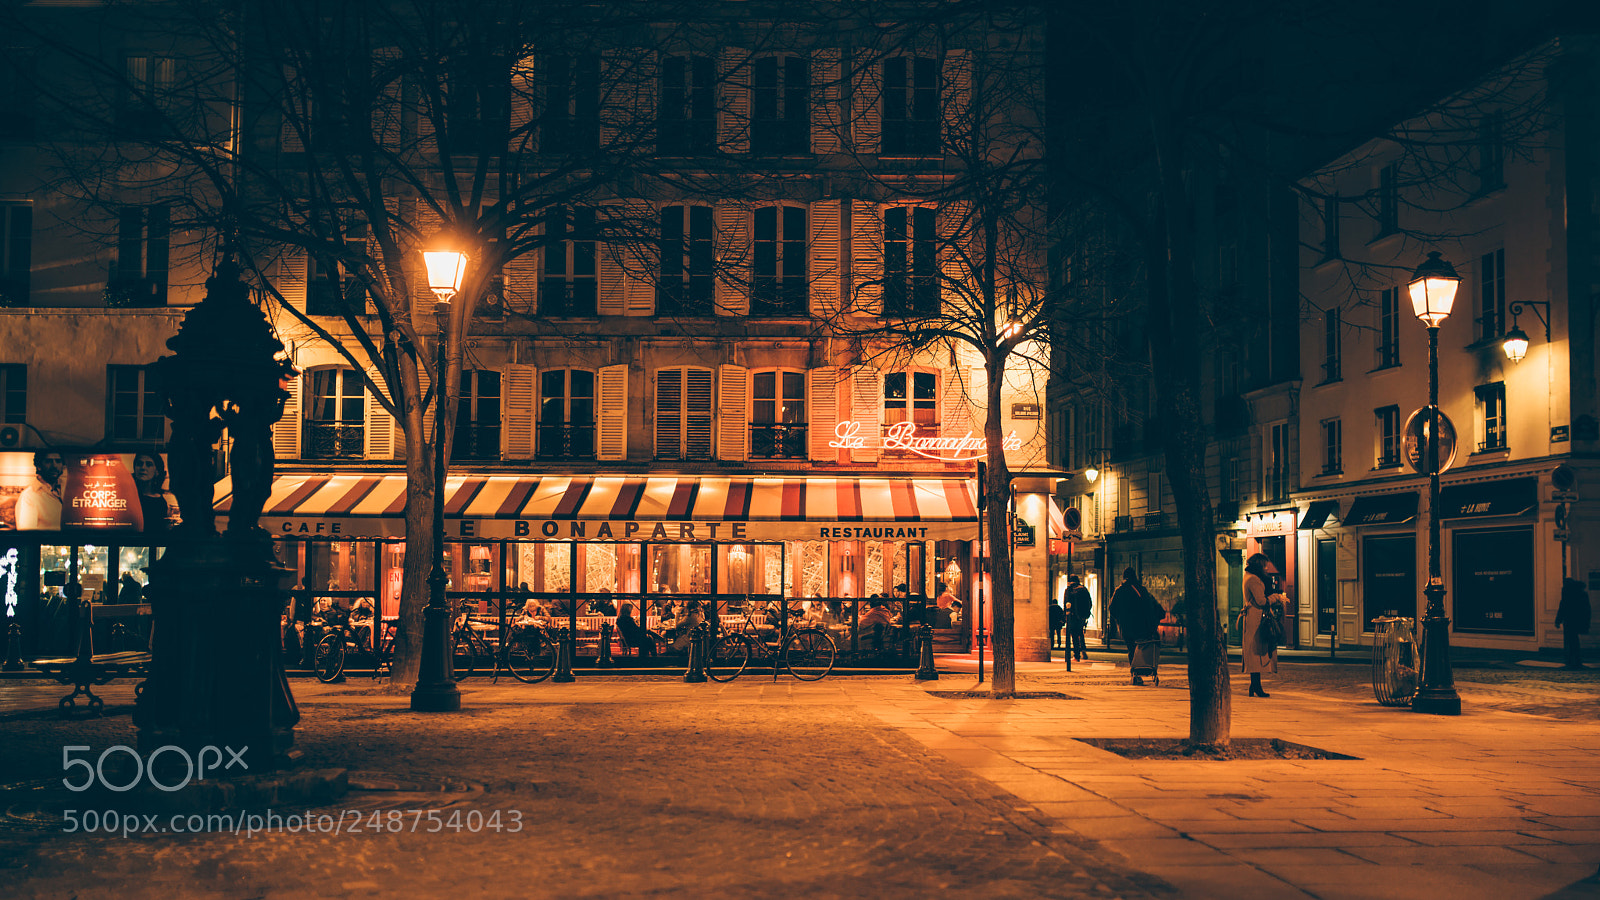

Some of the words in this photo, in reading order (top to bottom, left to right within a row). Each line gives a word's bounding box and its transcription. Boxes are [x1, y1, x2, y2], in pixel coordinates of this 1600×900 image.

[828, 421, 865, 449] Le
[884, 421, 1021, 461] Bonapate
[83, 490, 117, 499] CORPS
[72, 496, 127, 508] ÉTRANGER
[282, 522, 341, 533] CAFE
[514, 520, 747, 538] BONAPARTE
[820, 527, 928, 538] RESTAURANT
